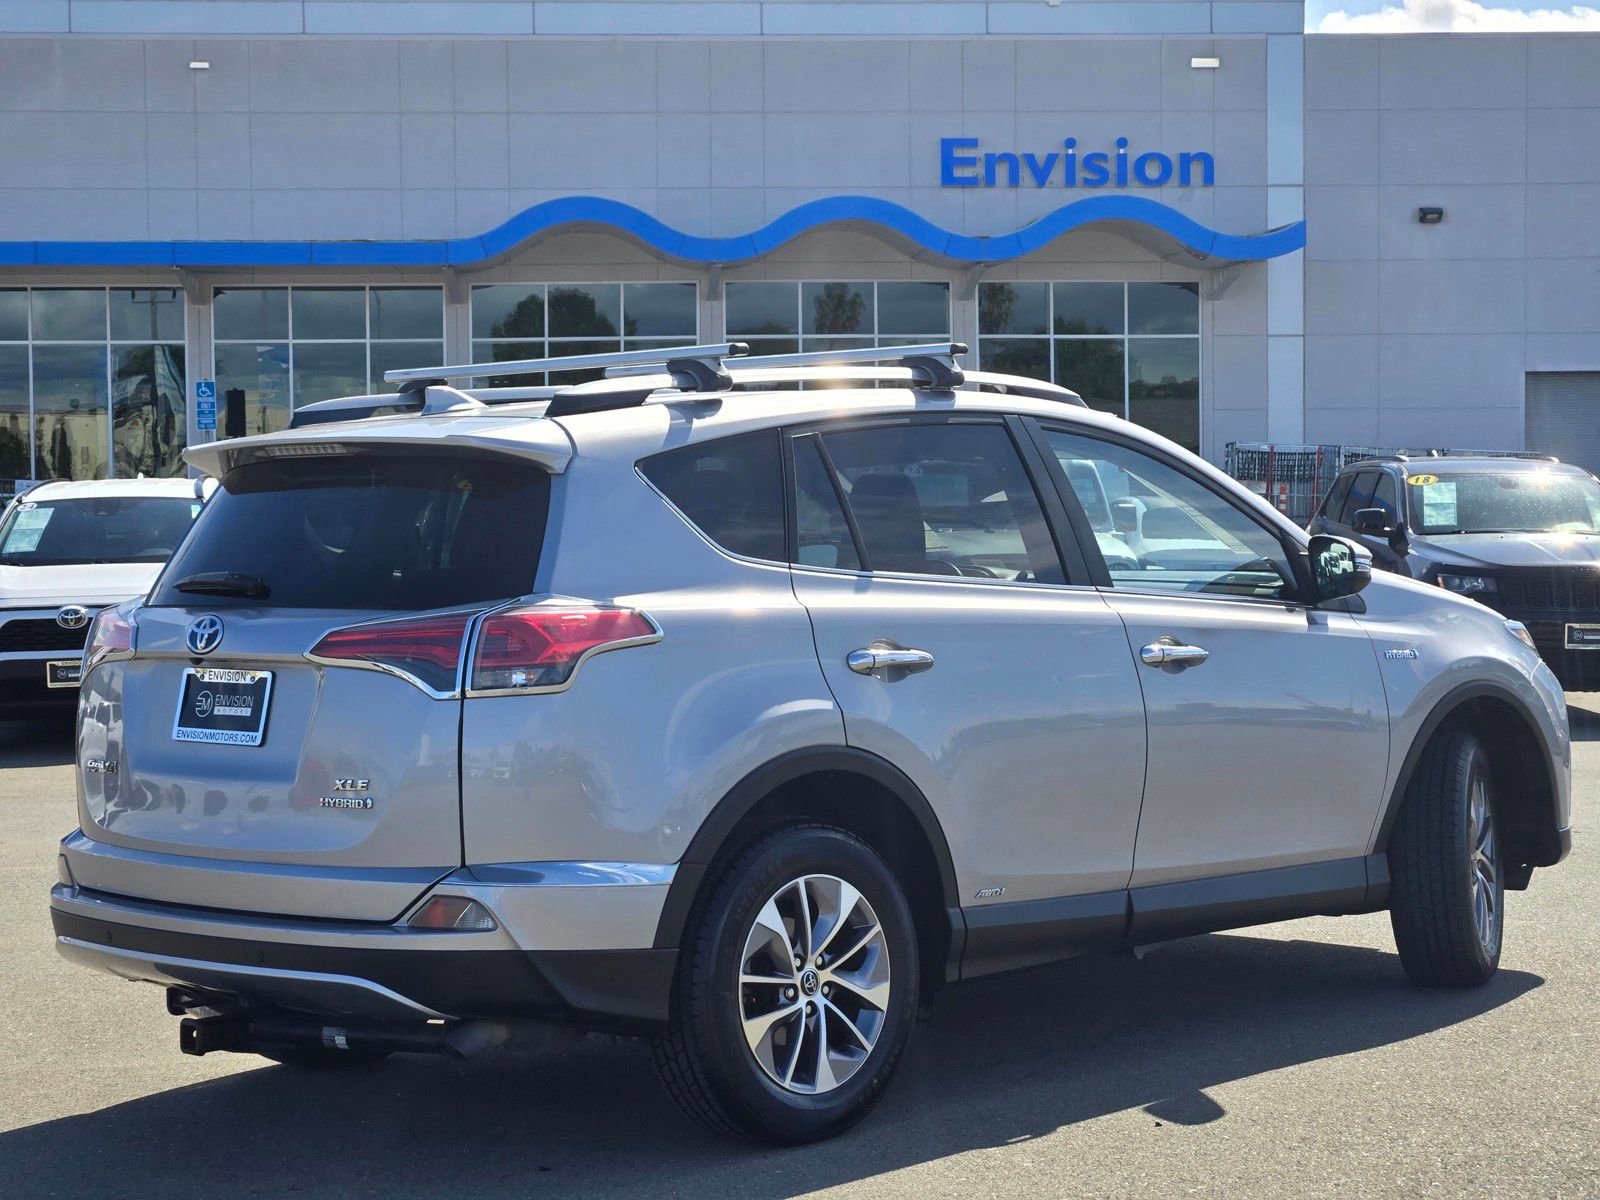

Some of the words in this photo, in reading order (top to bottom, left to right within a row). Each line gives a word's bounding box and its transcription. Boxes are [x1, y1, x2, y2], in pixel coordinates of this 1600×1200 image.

[940, 136, 1215, 188] Envision
[1384, 649, 1414, 660] HYBRID
[208, 670, 247, 682] ENVISION
[214, 694, 254, 707] ENVISION
[176, 729, 258, 744] ENVISIONMOTORS.COM
[332, 779, 370, 791] XLE
[319, 797, 364, 809] HYBRID
